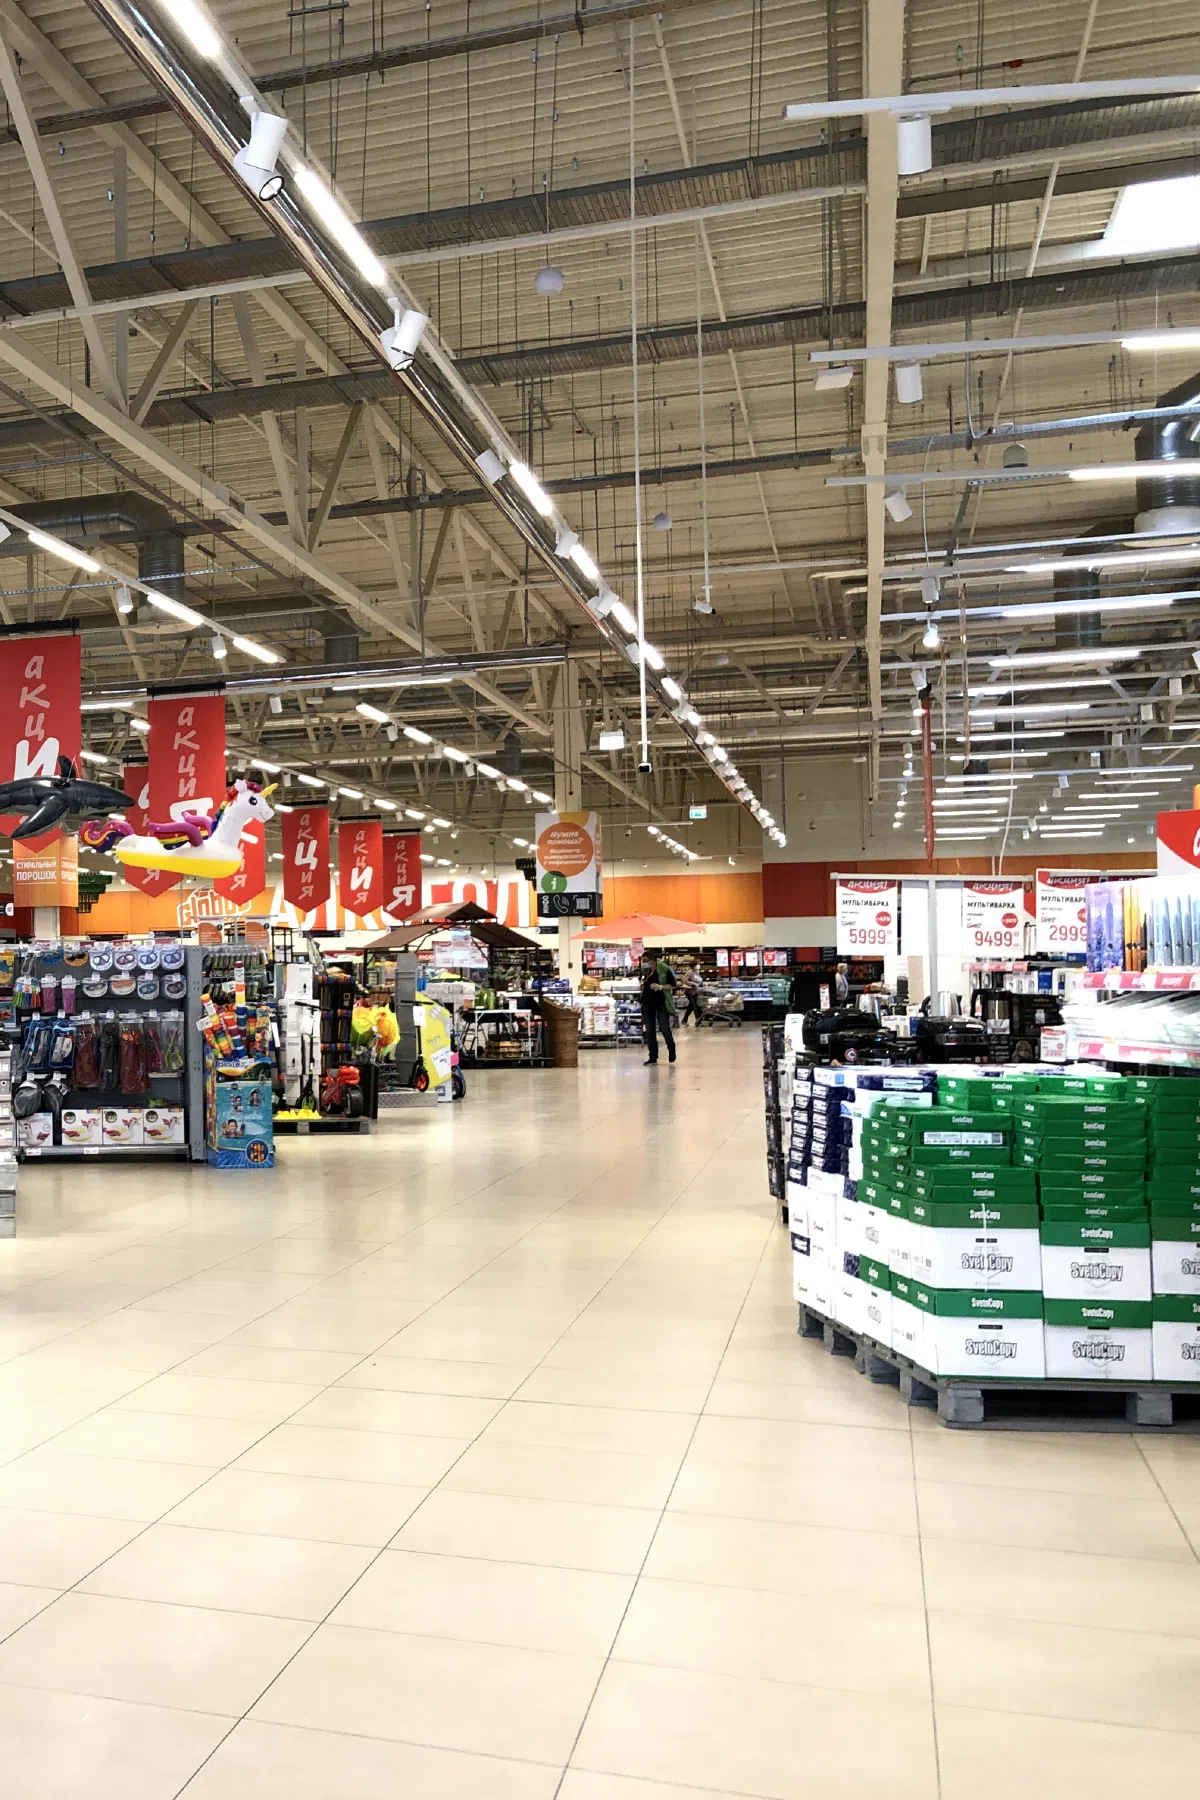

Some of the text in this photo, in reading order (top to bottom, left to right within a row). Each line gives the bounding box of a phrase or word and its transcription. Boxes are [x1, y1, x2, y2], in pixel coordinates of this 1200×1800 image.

[16, 860, 57, 869] СТИРАЛЬНЫЙ
[16, 871, 57, 881] ПОРОШОК
[842, 899, 890, 907] МУЛЬТИВАРКА
[1041, 895, 1086, 903] МУЛЬТИВАР
[849, 928, 886, 945] 5999
[974, 930, 1013, 947] 9499
[969, 1208, 1001, 1220] SvetCopy
[1080, 1227, 1114, 1240] SvetoCopy
[961, 1252, 1014, 1273] SvetCopy
[1070, 1261, 1124, 1282] SvetoCopy
[971, 1296, 1004, 1310] SvetoCopy
[1081, 1306, 1114, 1320] SvetoCopy
[965, 1338, 1018, 1359] SvetoCopy
[1072, 1340, 1126, 1362] SvetoCopy
